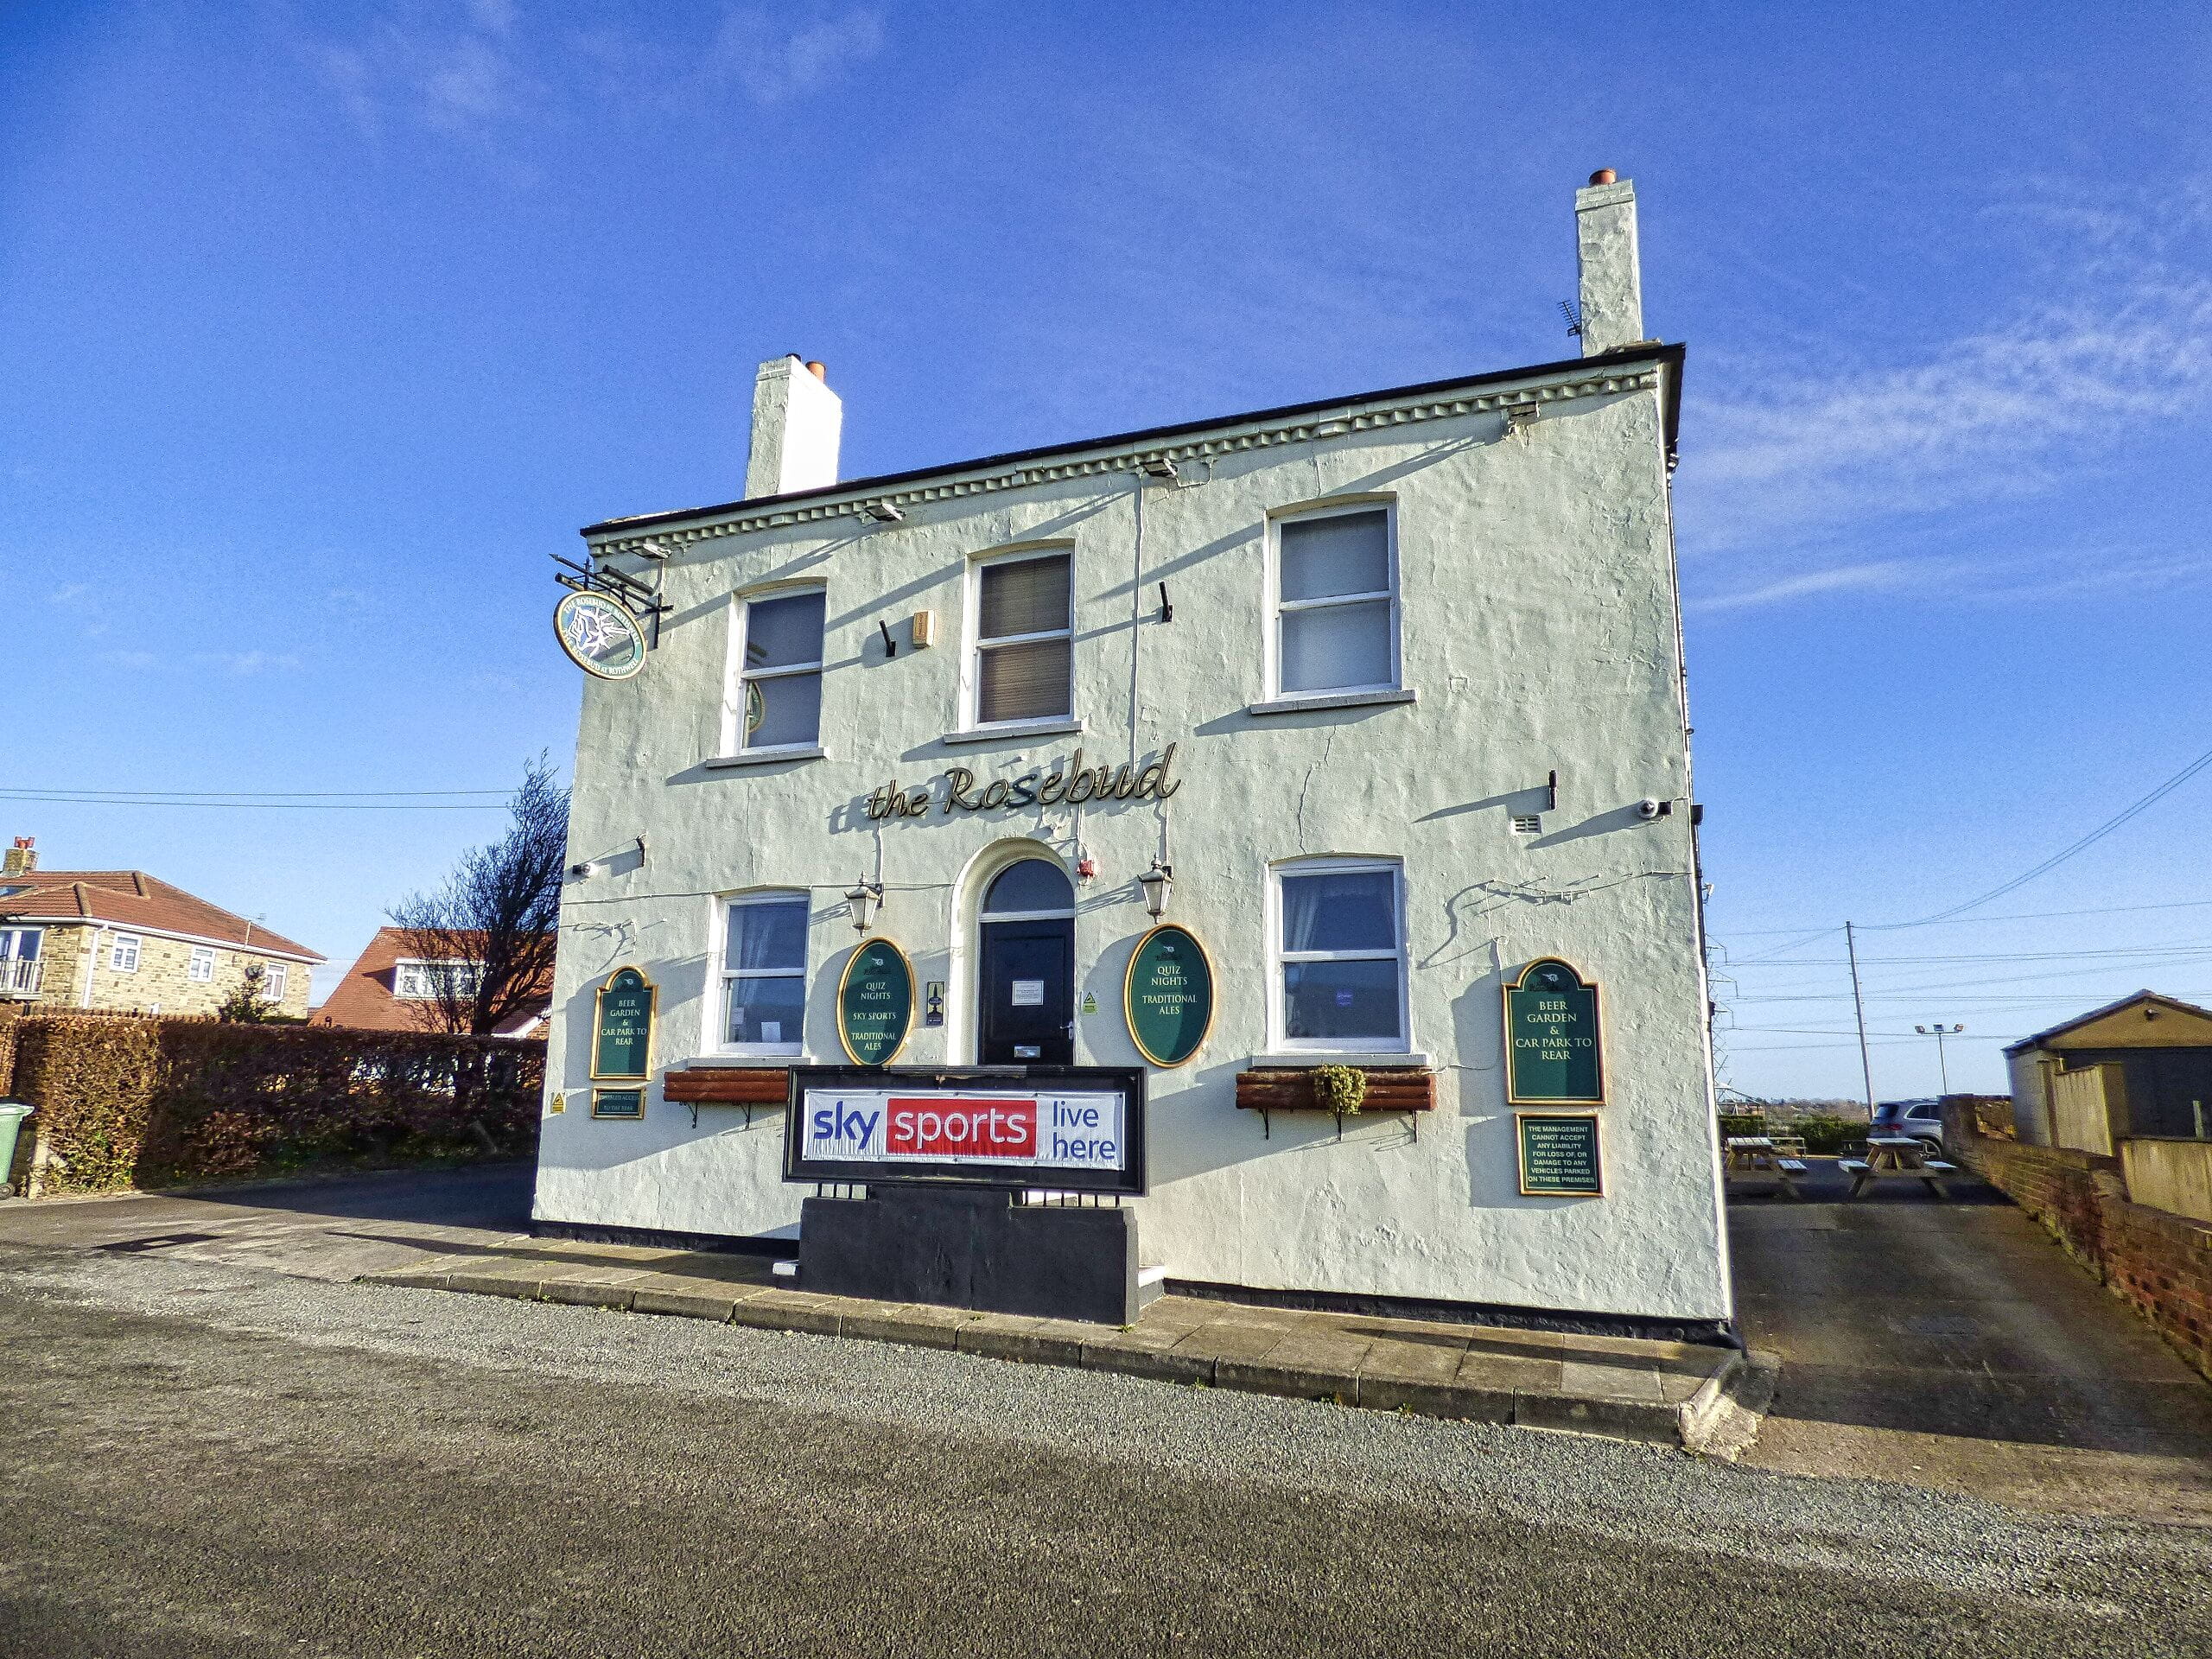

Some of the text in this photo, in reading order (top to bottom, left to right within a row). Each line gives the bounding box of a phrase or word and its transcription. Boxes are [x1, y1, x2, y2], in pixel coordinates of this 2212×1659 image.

[564, 601, 577, 614] THE
[868, 742, 1182, 819] the Rosebud
[1157, 966, 1181, 976] QUIZ
[1151, 976, 1188, 986] NIGHTS
[866, 982, 887, 991] QUIZ
[1141, 995, 1198, 1003] TRADITIONAL
[1159, 1006, 1180, 1014] ALES
[1539, 1001, 1567, 1011] BEER
[868, 1012, 896, 1020] SPORTS
[1527, 1014, 1577, 1023] GARDEN
[1550, 1027, 1560, 1035] &
[1516, 1038, 1592, 1048] CAR PARK TO
[1541, 1050, 1571, 1060] REAR
[1052, 1101, 1099, 1128] live
[813, 1100, 1027, 1150] sky sports
[1052, 1133, 1116, 1160] here
